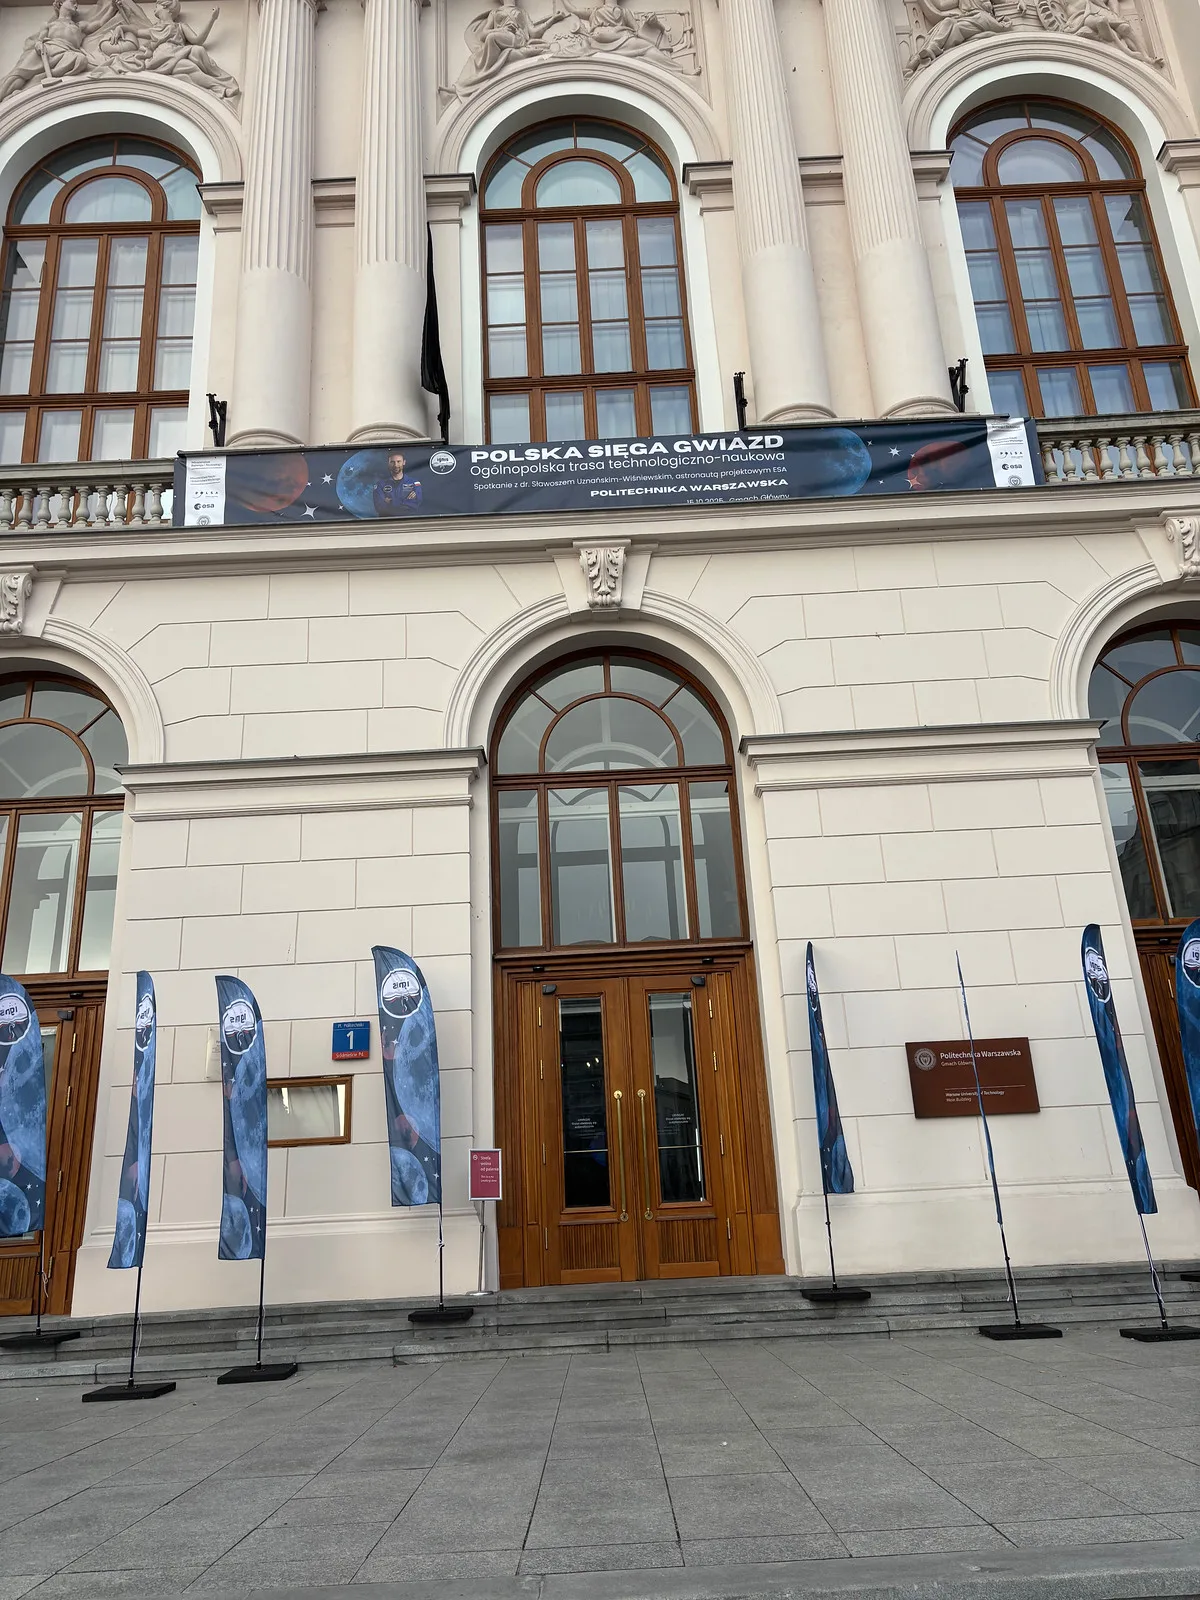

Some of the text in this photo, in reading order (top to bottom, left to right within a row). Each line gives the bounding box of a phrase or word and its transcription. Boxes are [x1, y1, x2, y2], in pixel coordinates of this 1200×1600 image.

[471, 435, 784, 463] POLSKA SIĘGA GWIAZD
[470, 452, 785, 478] Ogólnopolska trasa technologiczno-naukowa
[473, 481, 513, 490] Spotkanie
[519, 480, 530, 488] dr.
[531, 479, 576, 488] Sławoszem
[675, 472, 719, 480] astronautą
[720, 466, 772, 478] projektowym
[590, 479, 788, 497] POLITECHNIKA WARSZAWSKA
[346, 1030, 354, 1050] 1
[940, 1049, 1021, 1059] Politechnka Warszawska
